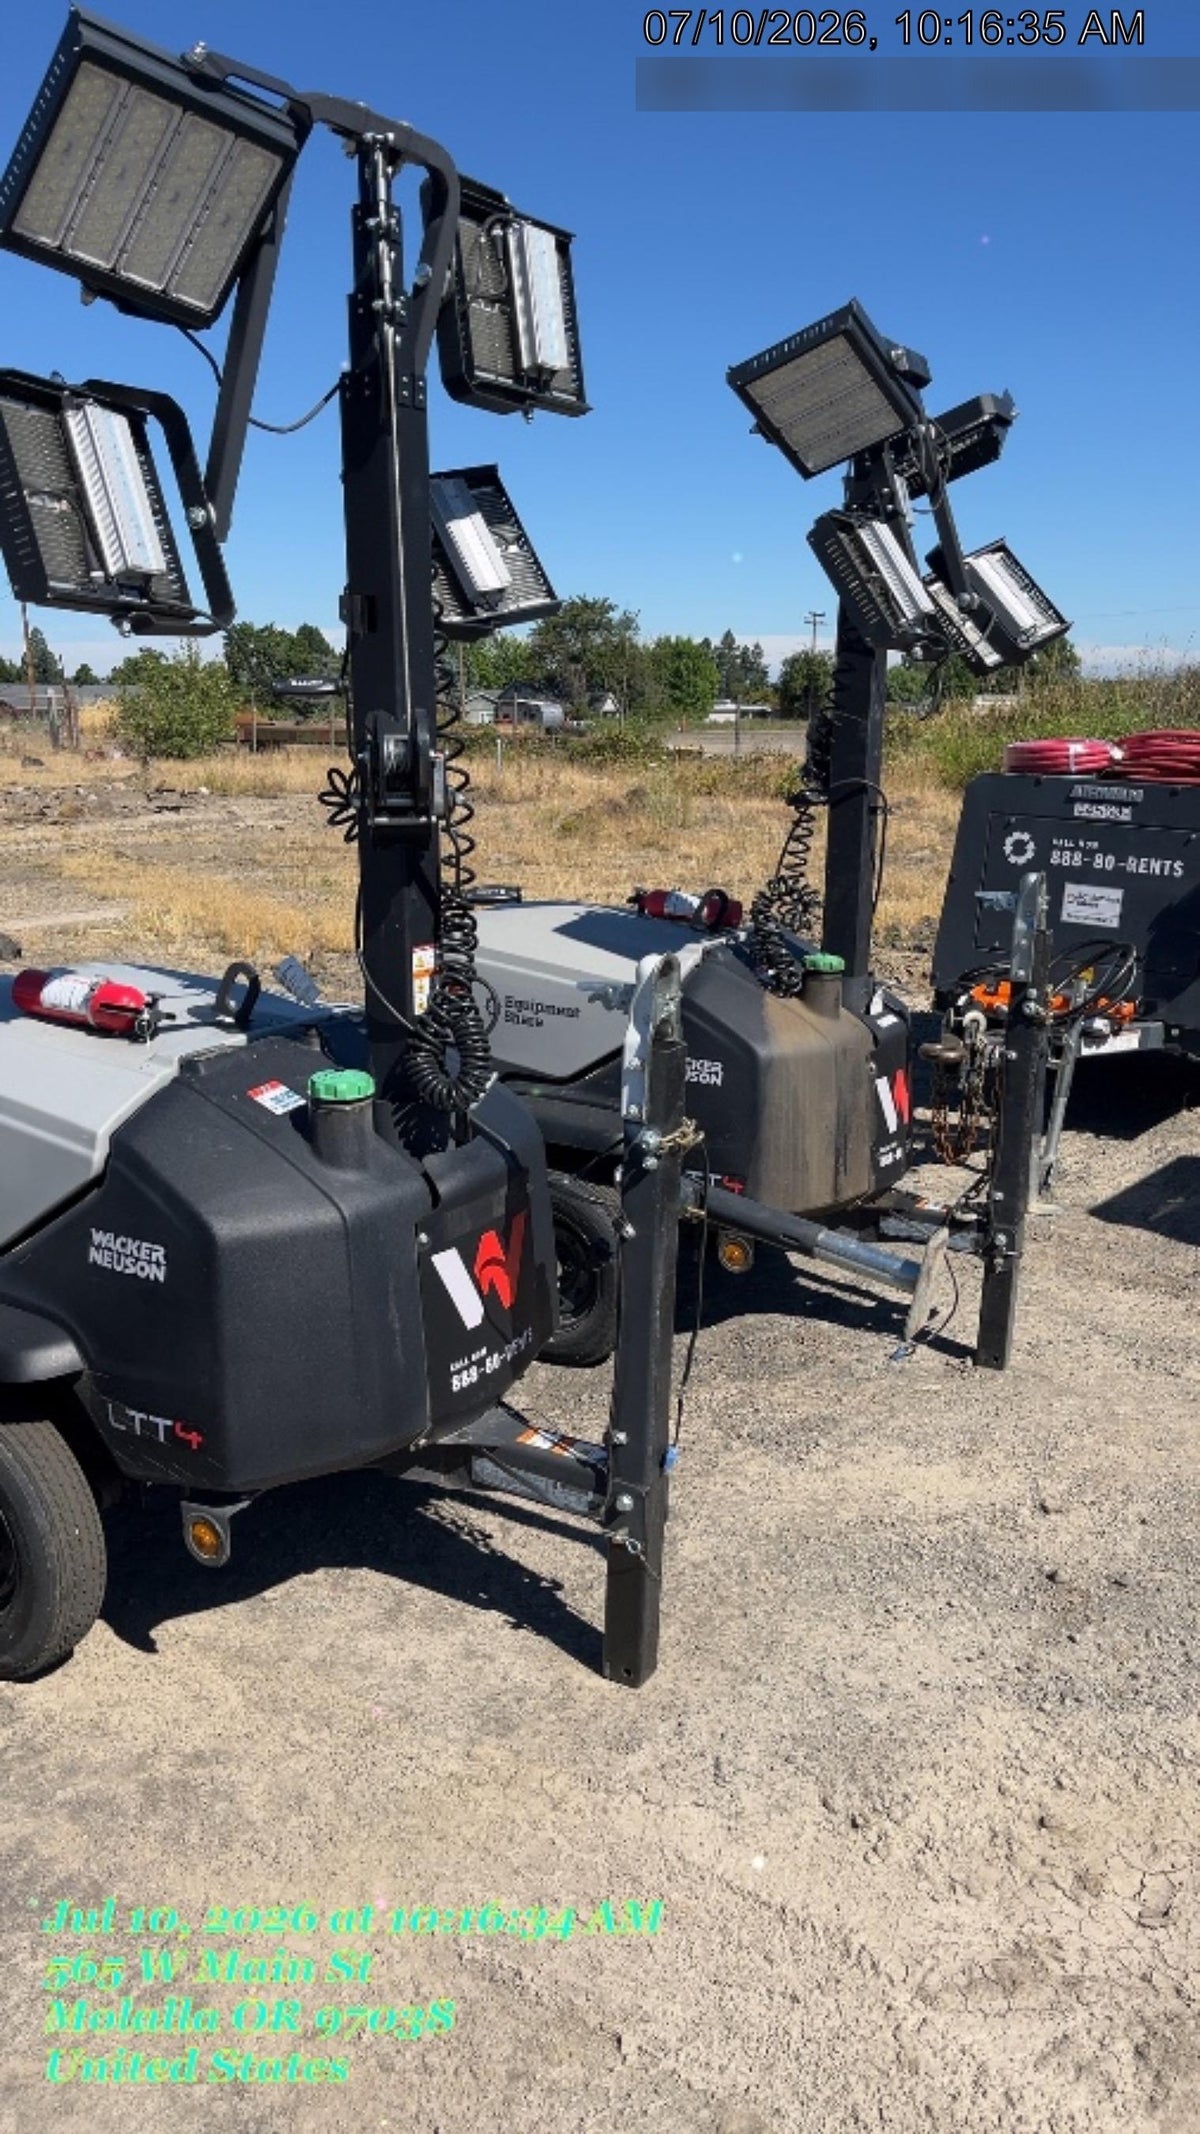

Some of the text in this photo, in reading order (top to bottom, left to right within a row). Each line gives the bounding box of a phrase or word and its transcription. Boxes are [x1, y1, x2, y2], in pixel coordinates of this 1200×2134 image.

[1050, 849, 1184, 878] 888-80-RENTS
[88, 1246, 167, 1284] NEUSON
[90, 1228, 167, 1265] WACKER
[108, 1402, 203, 1450] LTT4
